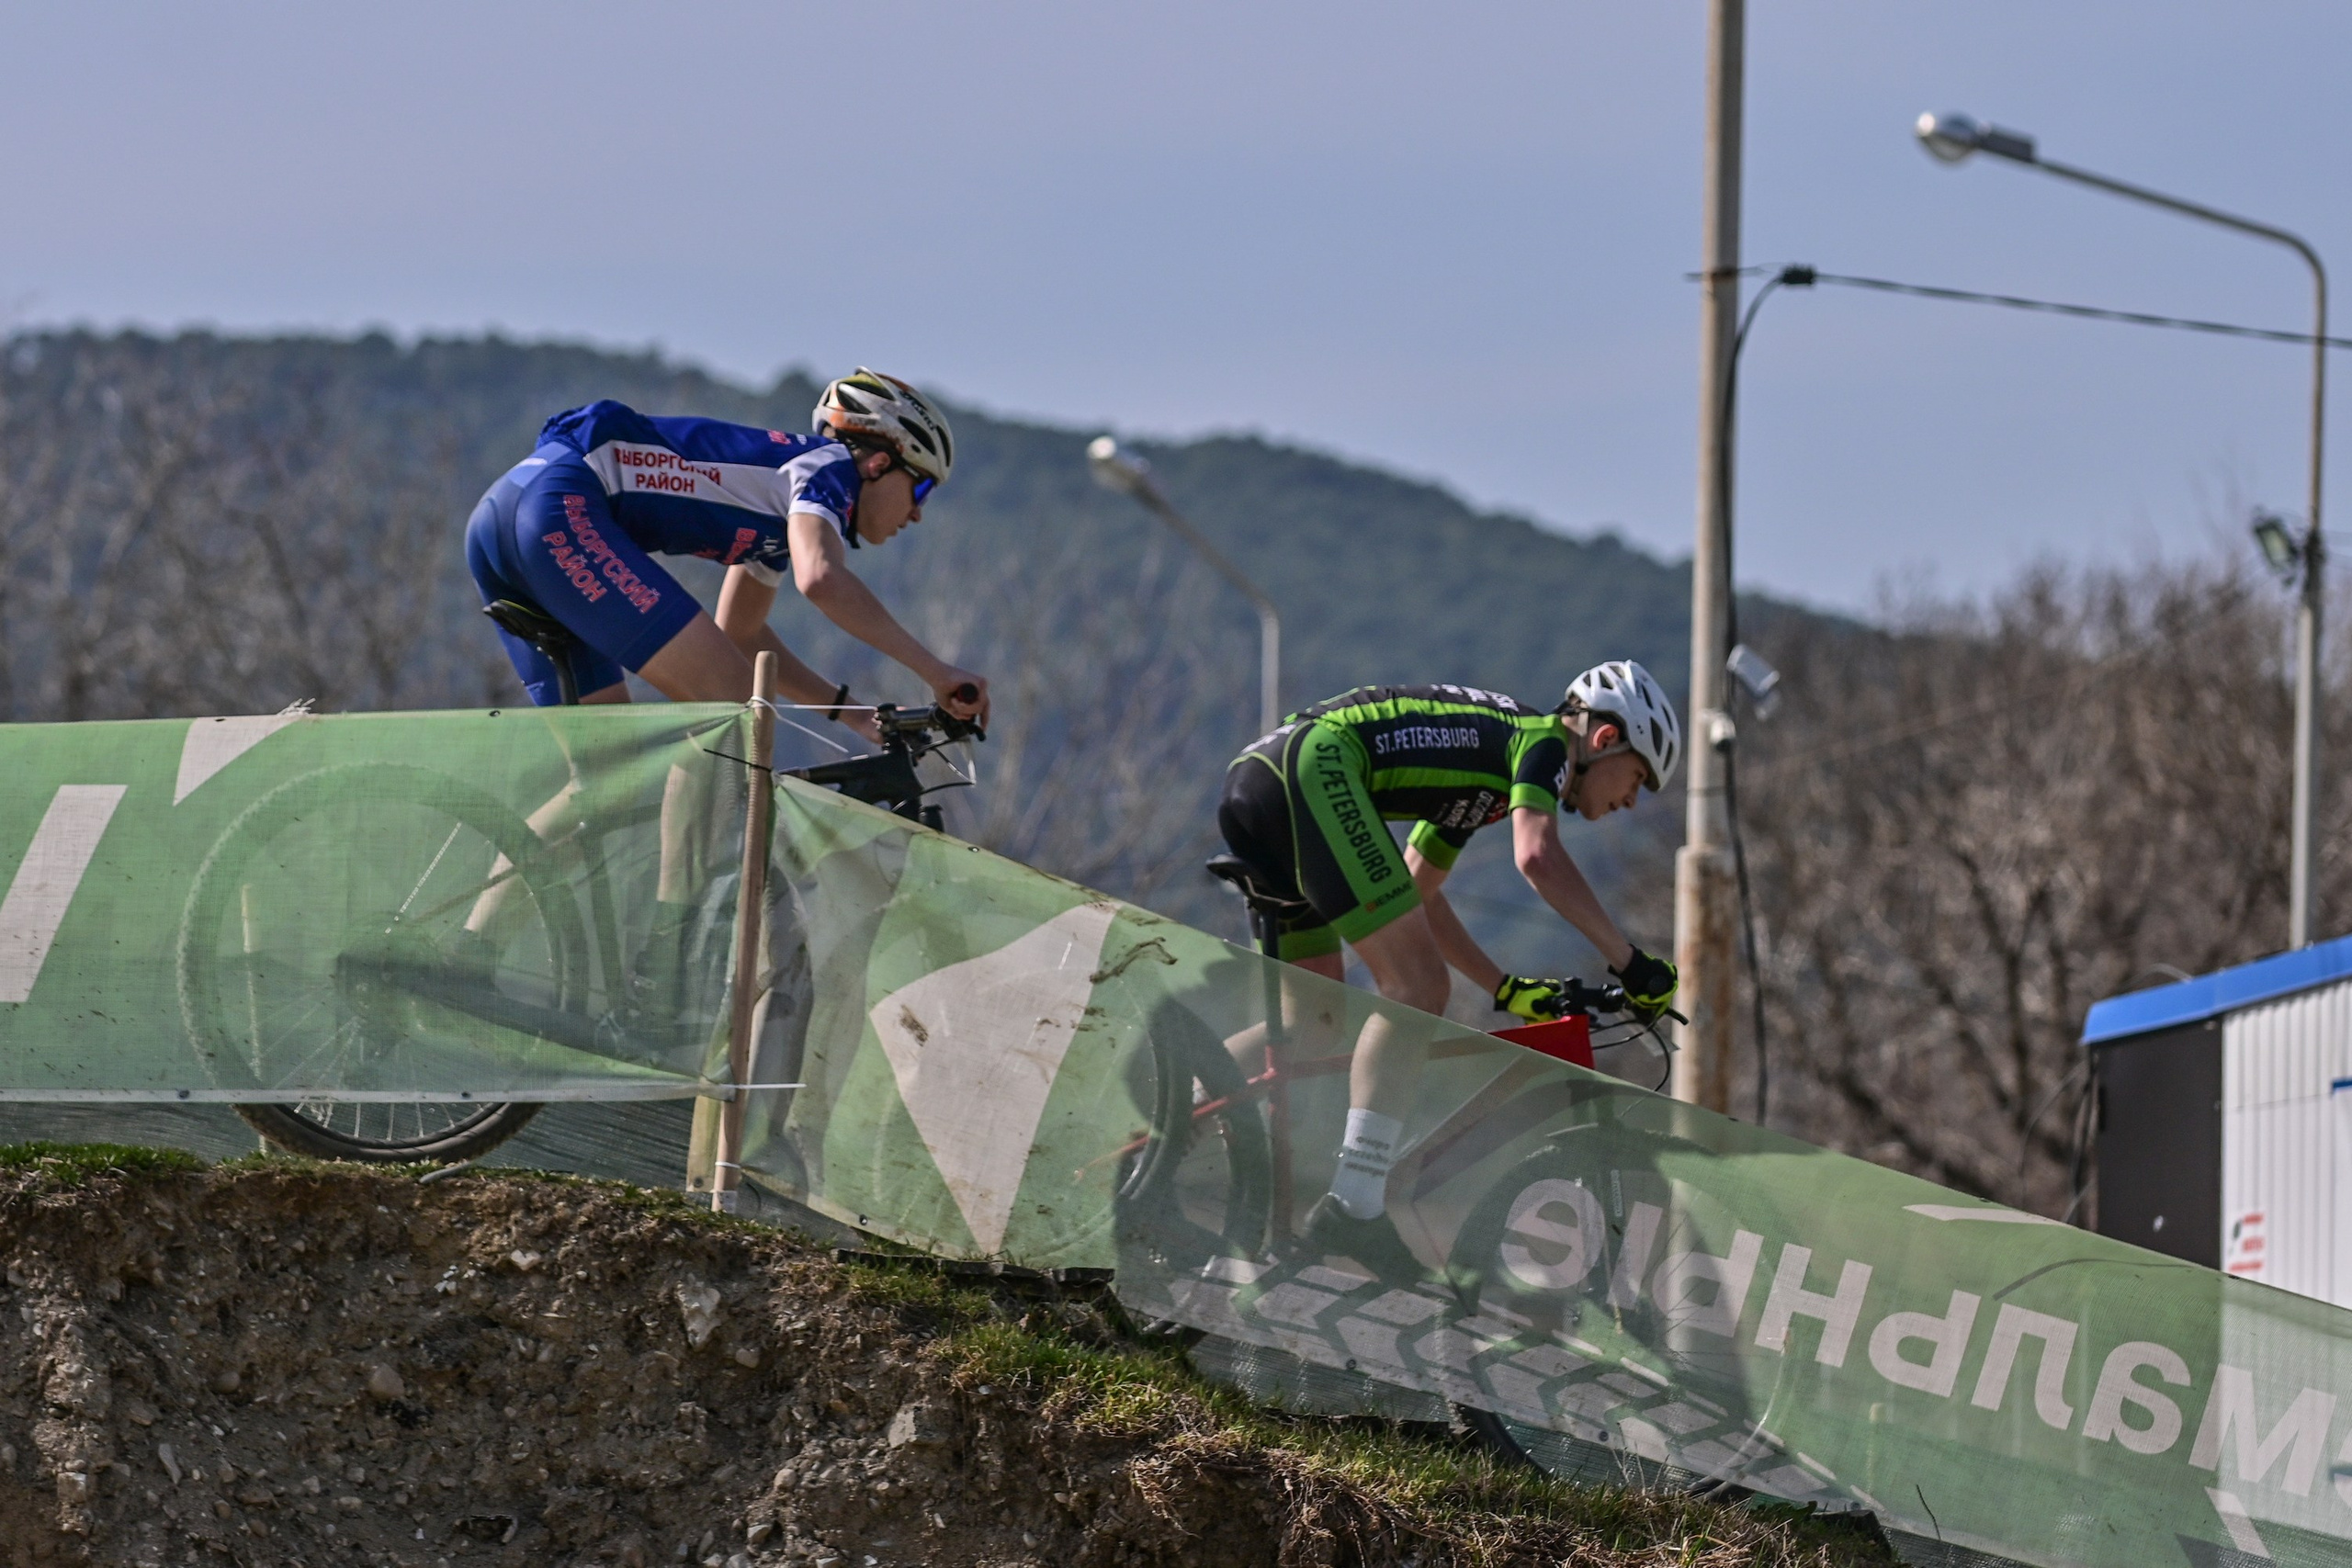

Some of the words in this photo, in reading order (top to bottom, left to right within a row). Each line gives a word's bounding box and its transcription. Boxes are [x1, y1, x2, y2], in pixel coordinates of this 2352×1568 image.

[613, 447, 721, 486] ЫБОРГСЙ
[635, 471, 695, 492] РАЙОН
[541, 530, 608, 603] РАЙОН
[562, 494, 662, 615] ВЫБОРГСКИЙ
[1374, 726, 1480, 754] ST.PETERSBURG
[1315, 741, 1393, 884] ST.PETERSBURG
